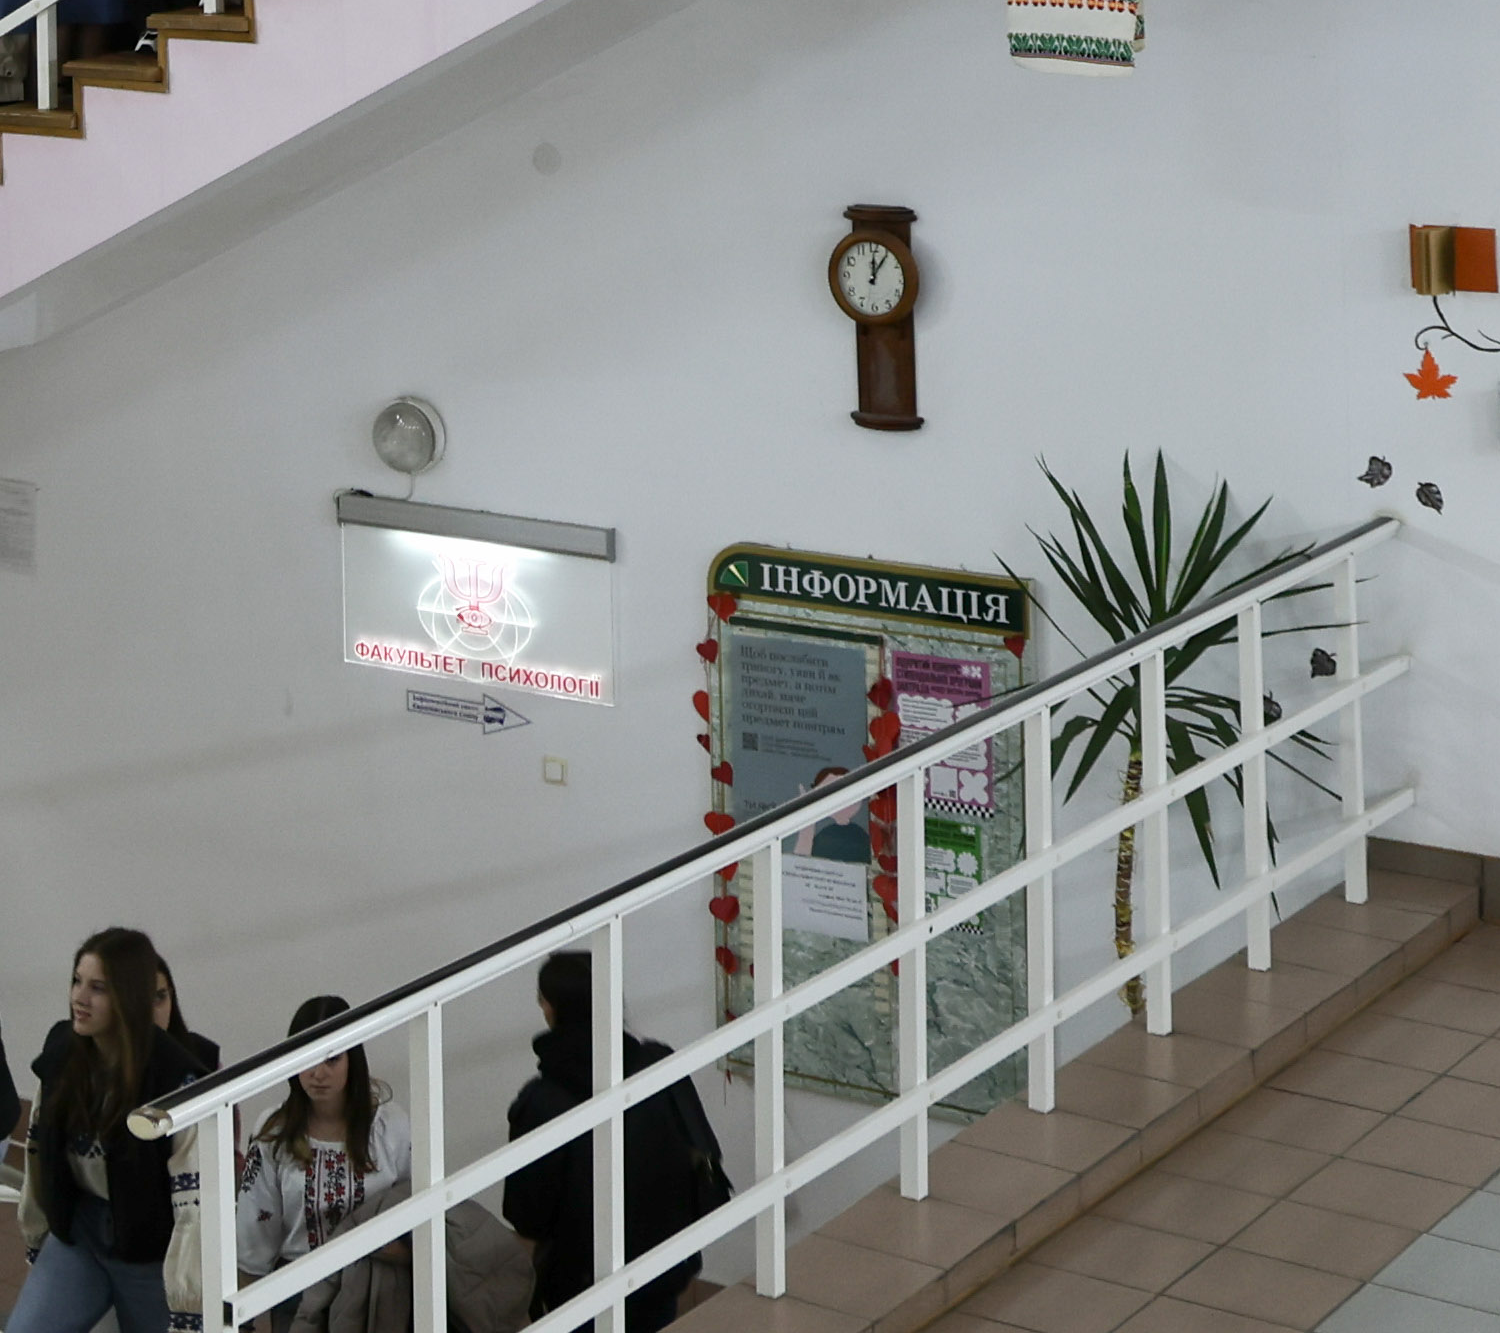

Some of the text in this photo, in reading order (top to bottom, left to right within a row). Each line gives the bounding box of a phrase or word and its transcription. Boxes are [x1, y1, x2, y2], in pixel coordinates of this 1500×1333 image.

[759, 563, 1010, 624] ІНФОРМАЦІЯ
[354, 641, 602, 698] ФАКУЛЬТЕТ ПСИХОЛОГІЇ
